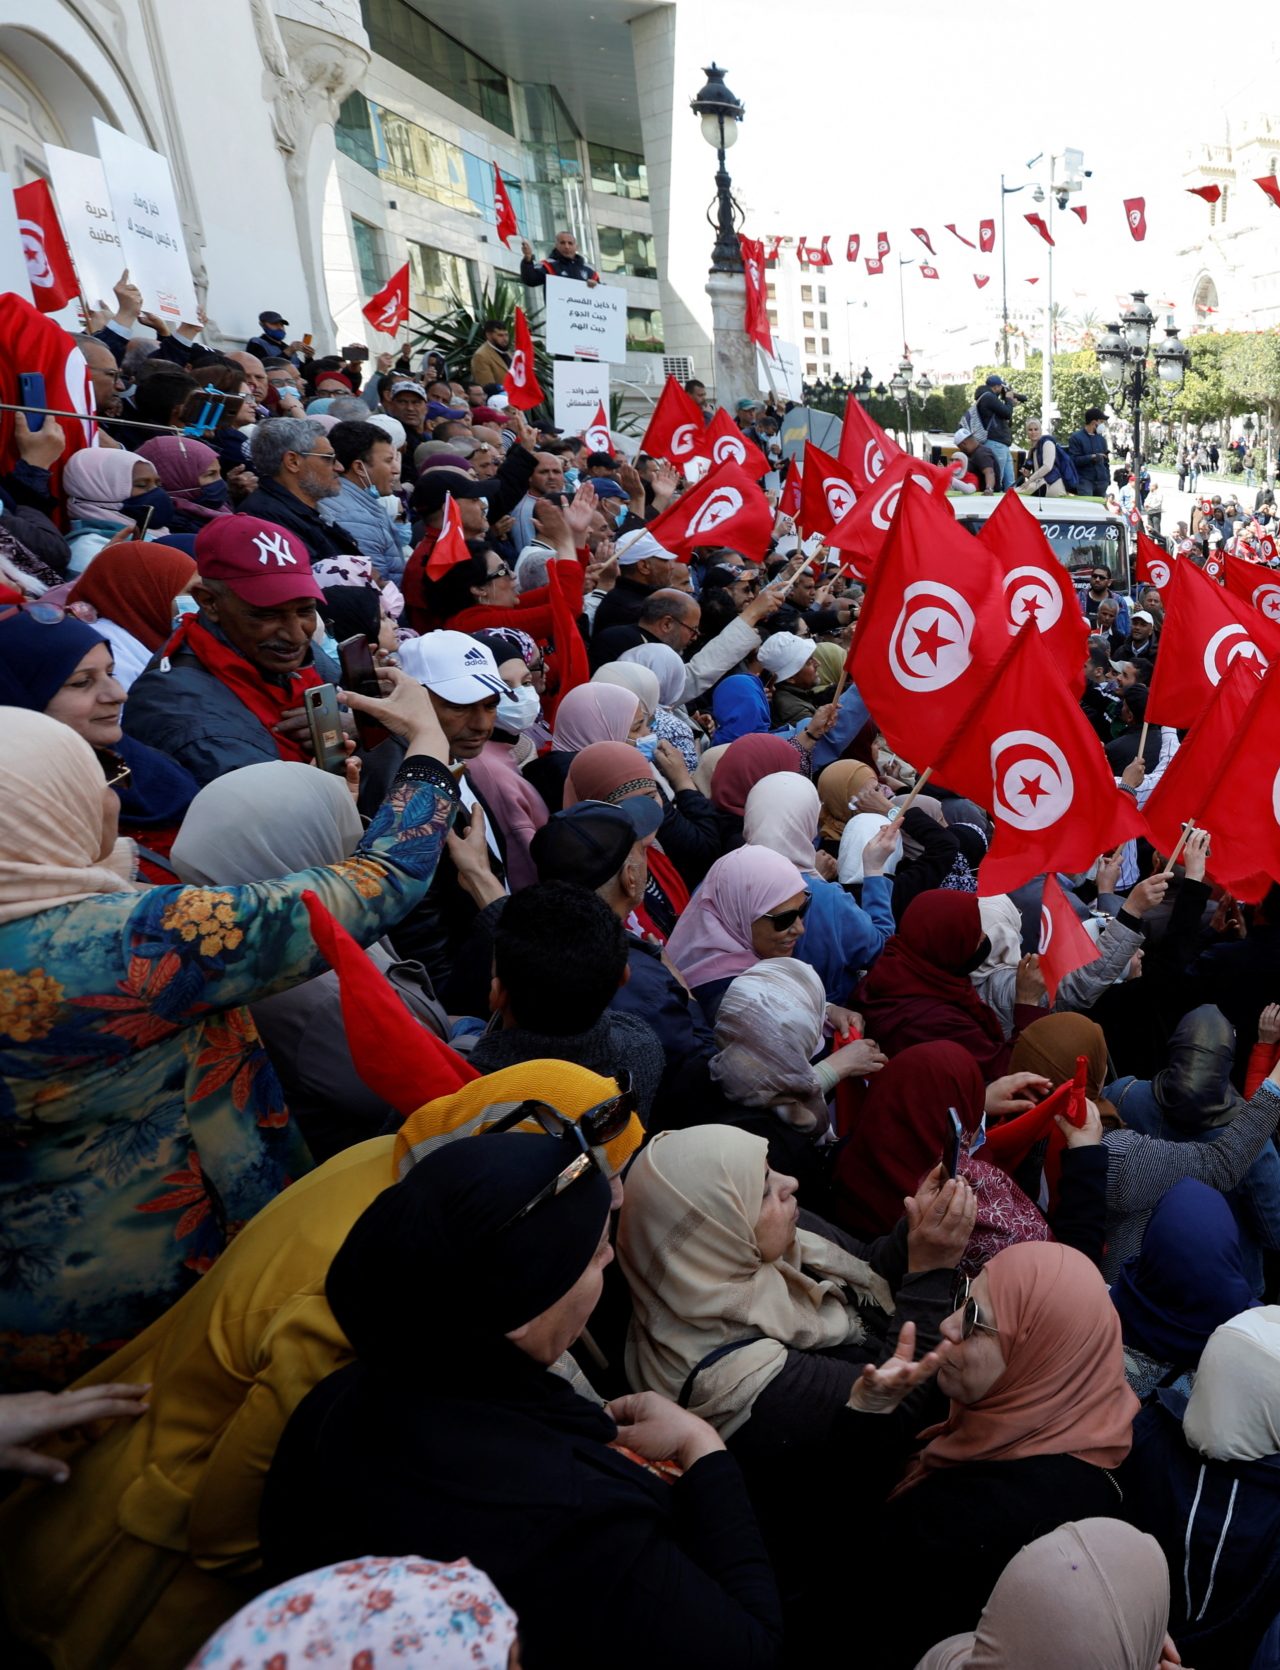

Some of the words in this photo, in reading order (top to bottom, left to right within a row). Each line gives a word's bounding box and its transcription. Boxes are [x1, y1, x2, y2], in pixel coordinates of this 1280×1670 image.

[85, 200, 108, 219] حرية
[89, 226, 121, 248] وطنية
[134, 223, 154, 239] سعيد
[252, 531, 297, 566] NY
